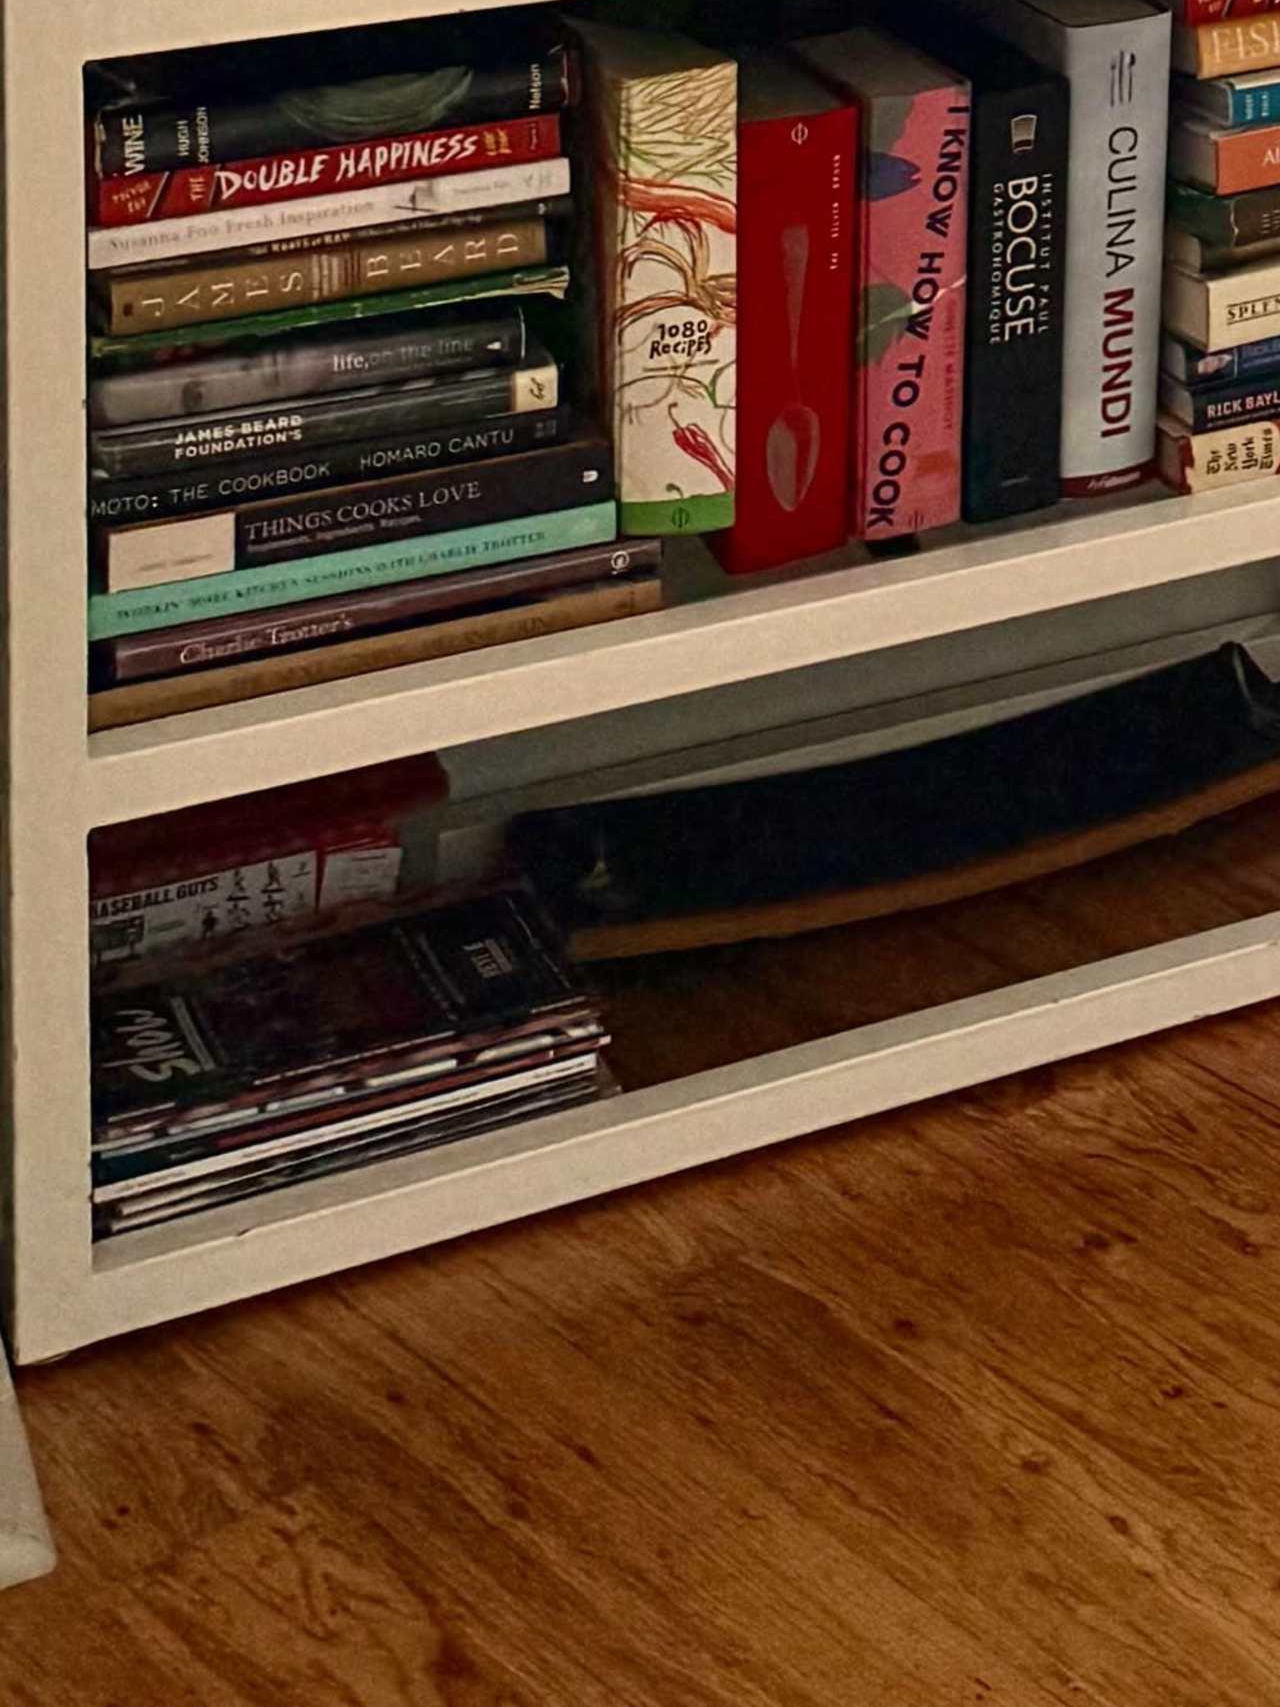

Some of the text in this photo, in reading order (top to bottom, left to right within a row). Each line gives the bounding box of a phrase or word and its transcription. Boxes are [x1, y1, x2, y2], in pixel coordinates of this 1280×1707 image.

[123, 114, 145, 176] WINE
[216, 133, 480, 200] DOUBLE HAPPINESS
[866, 105, 971, 529] I KNOW HOW TO COOK
[989, 182, 1004, 345] GASTRONOMIQUE
[1004, 175, 1038, 344] BOCUSE
[1037, 173, 1053, 334] INSTITUT PAUL
[1099, 126, 1139, 439] CULINA MUNDI
[174, 415, 304, 445] JAMES BEARD
[244, 481, 483, 541] THINGS COOKS LOVE
